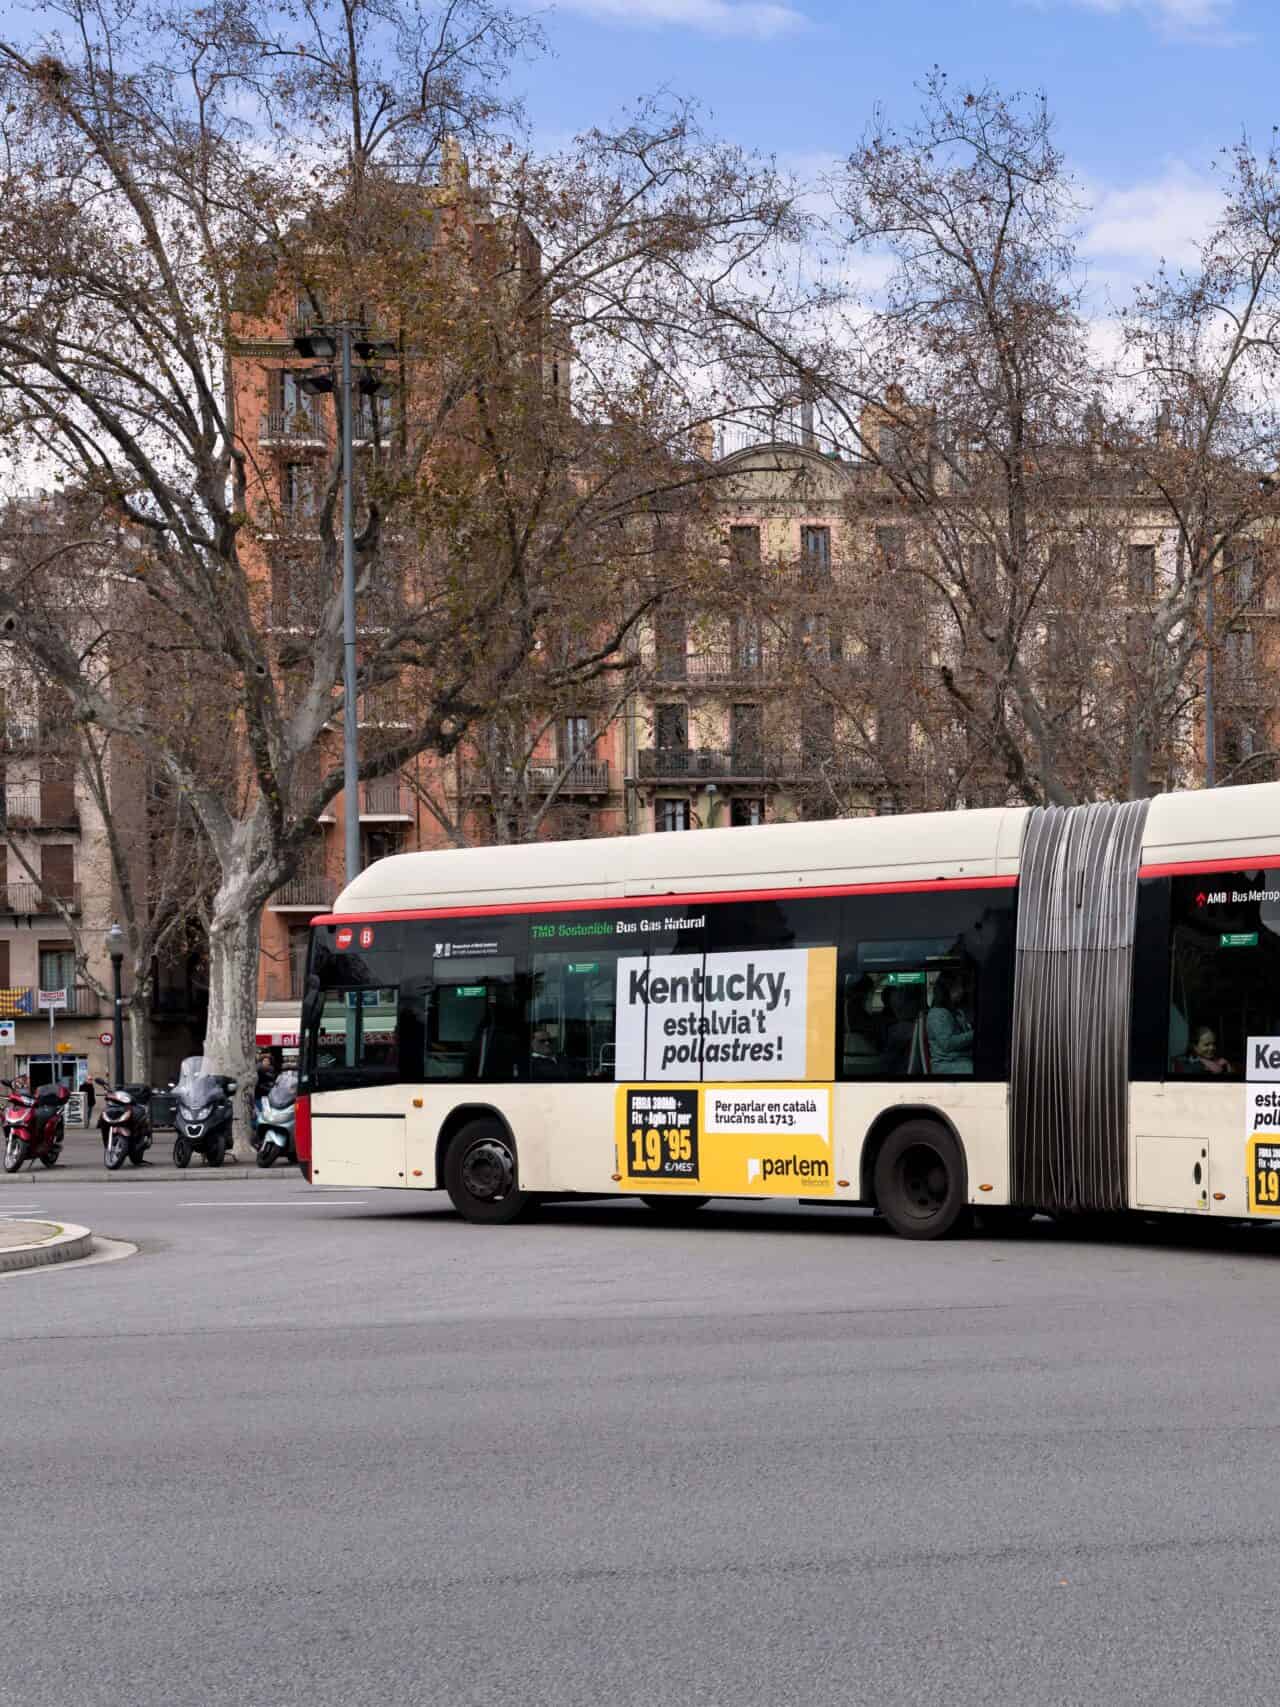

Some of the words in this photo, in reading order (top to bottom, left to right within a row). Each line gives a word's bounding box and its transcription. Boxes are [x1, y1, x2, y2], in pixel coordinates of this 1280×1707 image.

[1207, 892, 1227, 904] AMB
[1232, 890, 1248, 903] Bus
[616, 921, 637, 934] Bus
[640, 919, 662, 932] Gas
[664, 915, 706, 931] Natural
[629, 964, 791, 1011] Kentucky,
[663, 1009, 767, 1037] estalvia't
[662, 1036, 783, 1070] pollastres!
[715, 1100, 732, 1112] Per
[734, 1100, 767, 1114] parlar
[767, 1102, 781, 1112] en
[783, 1100, 817, 1113] català
[715, 1112, 756, 1124] truca'ns
[757, 1112, 768, 1124] al
[769, 1114, 797, 1126] 1713.
[631, 1128, 662, 1172] 19
[762, 1154, 829, 1181] parlem
[1258, 1170, 1279, 1202] 19
